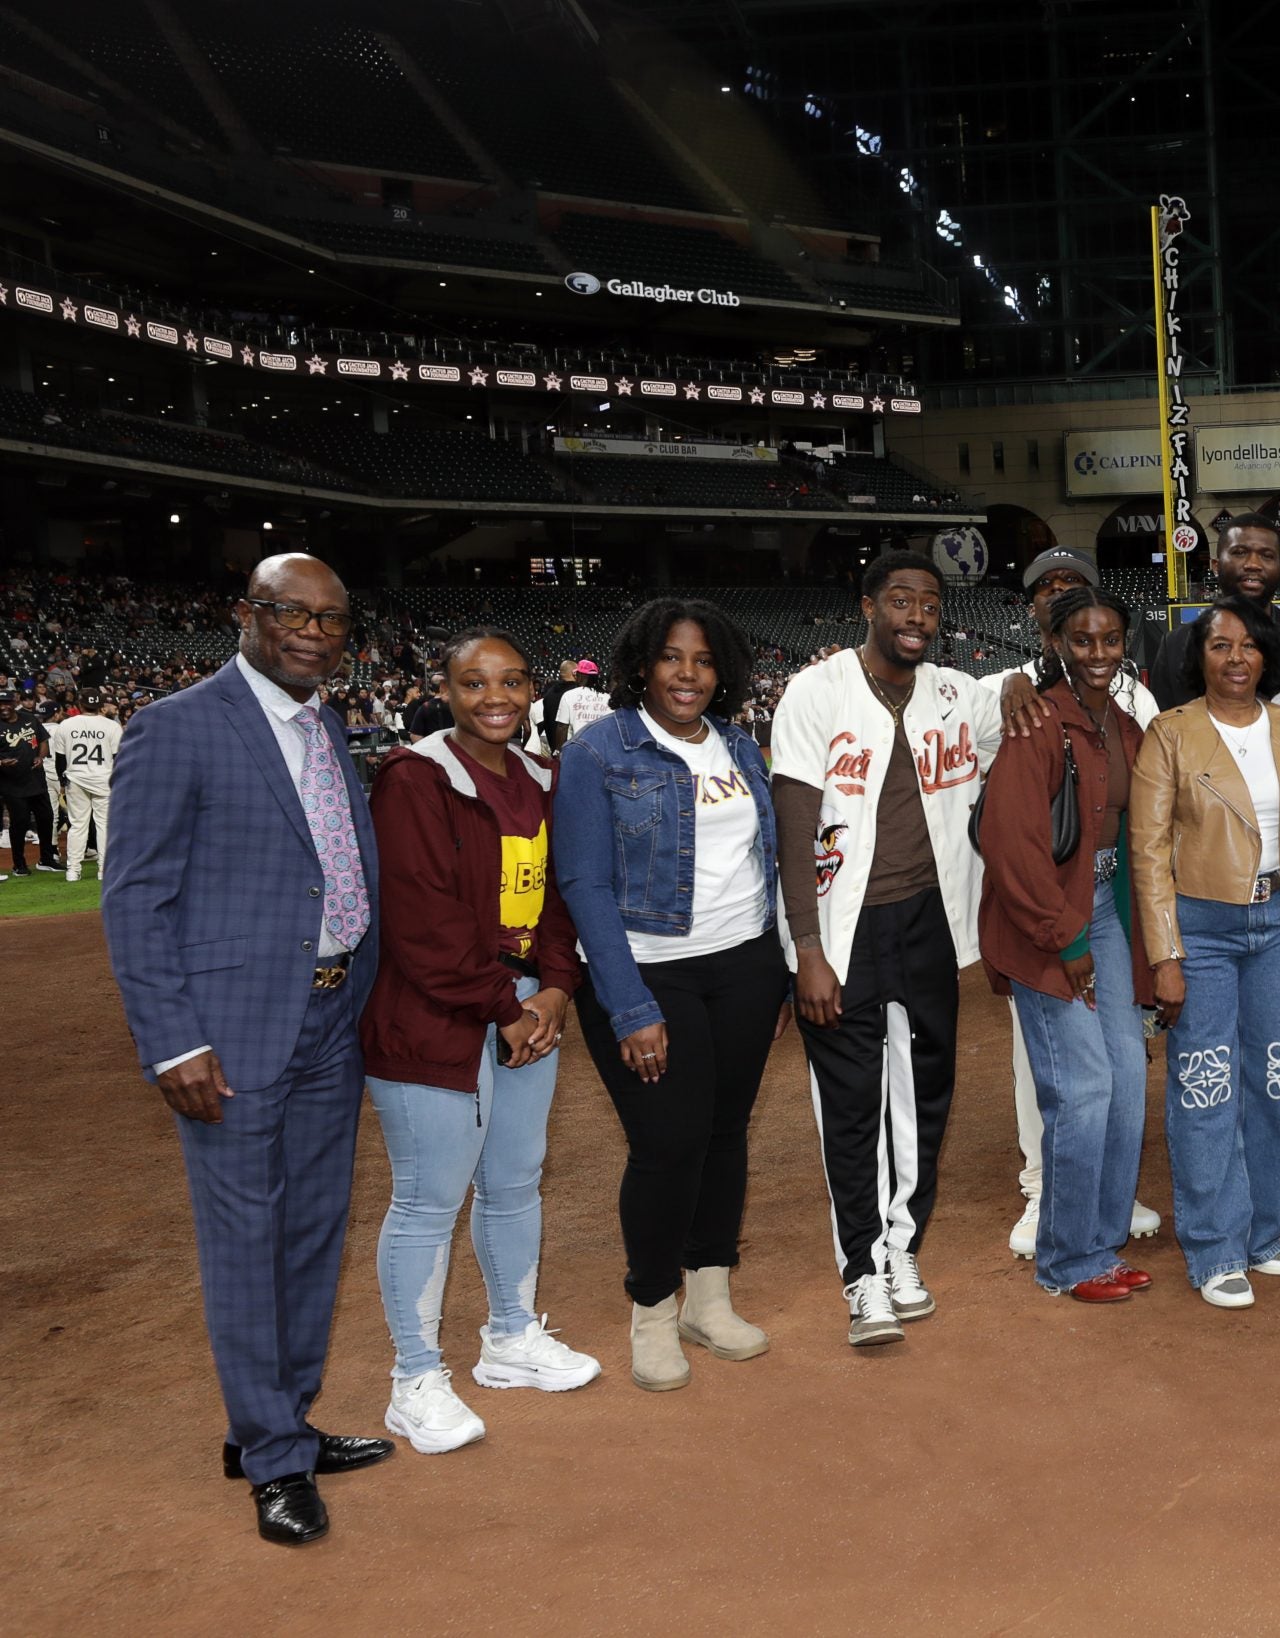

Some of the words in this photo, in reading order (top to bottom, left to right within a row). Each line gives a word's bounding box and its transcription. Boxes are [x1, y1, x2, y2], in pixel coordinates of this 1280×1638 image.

[393, 208, 408, 219] 20
[606, 278, 695, 303] Gallagher
[697, 288, 741, 307] Club
[1163, 247, 1182, 378] CHIKIN
[1169, 384, 1188, 425] IZ
[659, 444, 680, 454] CLUB
[681, 445, 697, 455] BAR
[1234, 461, 1272, 471] Advancing
[1172, 433, 1191, 523] FAIR
[1145, 610, 1167, 621] 315
[88, 695, 100, 704] CJ
[70, 730, 105, 740] CANO
[71, 743, 105, 766] 24
